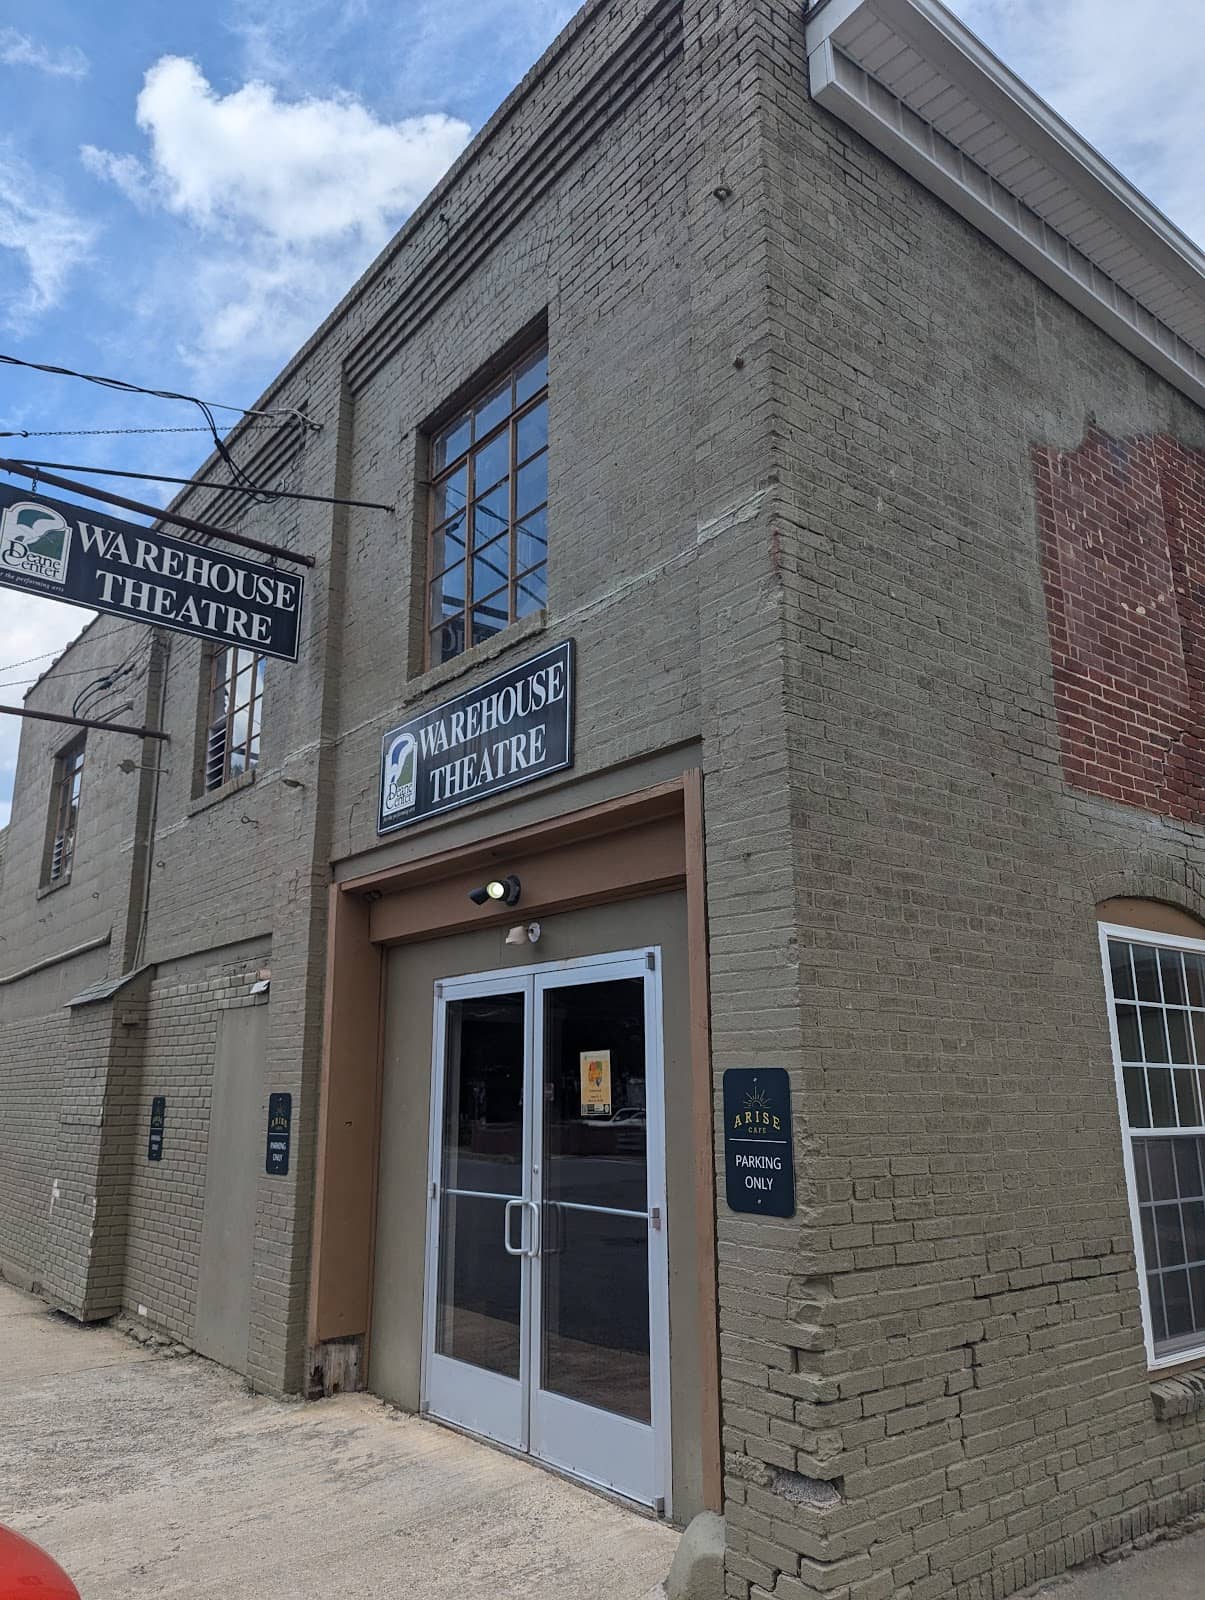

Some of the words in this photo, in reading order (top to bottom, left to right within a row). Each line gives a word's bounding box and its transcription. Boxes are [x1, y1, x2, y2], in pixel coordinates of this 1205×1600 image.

[2, 549, 60, 578] Center
[9, 540, 62, 570] Deane
[77, 520, 296, 612] WAREHOUSE
[96, 570, 272, 644] THEATRE
[418, 661, 565, 760] WAREHOUSE
[430, 724, 547, 803] THEATRE
[734, 1111, 781, 1130] ARISE
[748, 1126, 767, 1134] CAFE
[735, 1154, 782, 1170] PARKING
[744, 1175, 773, 1190] ONLY
